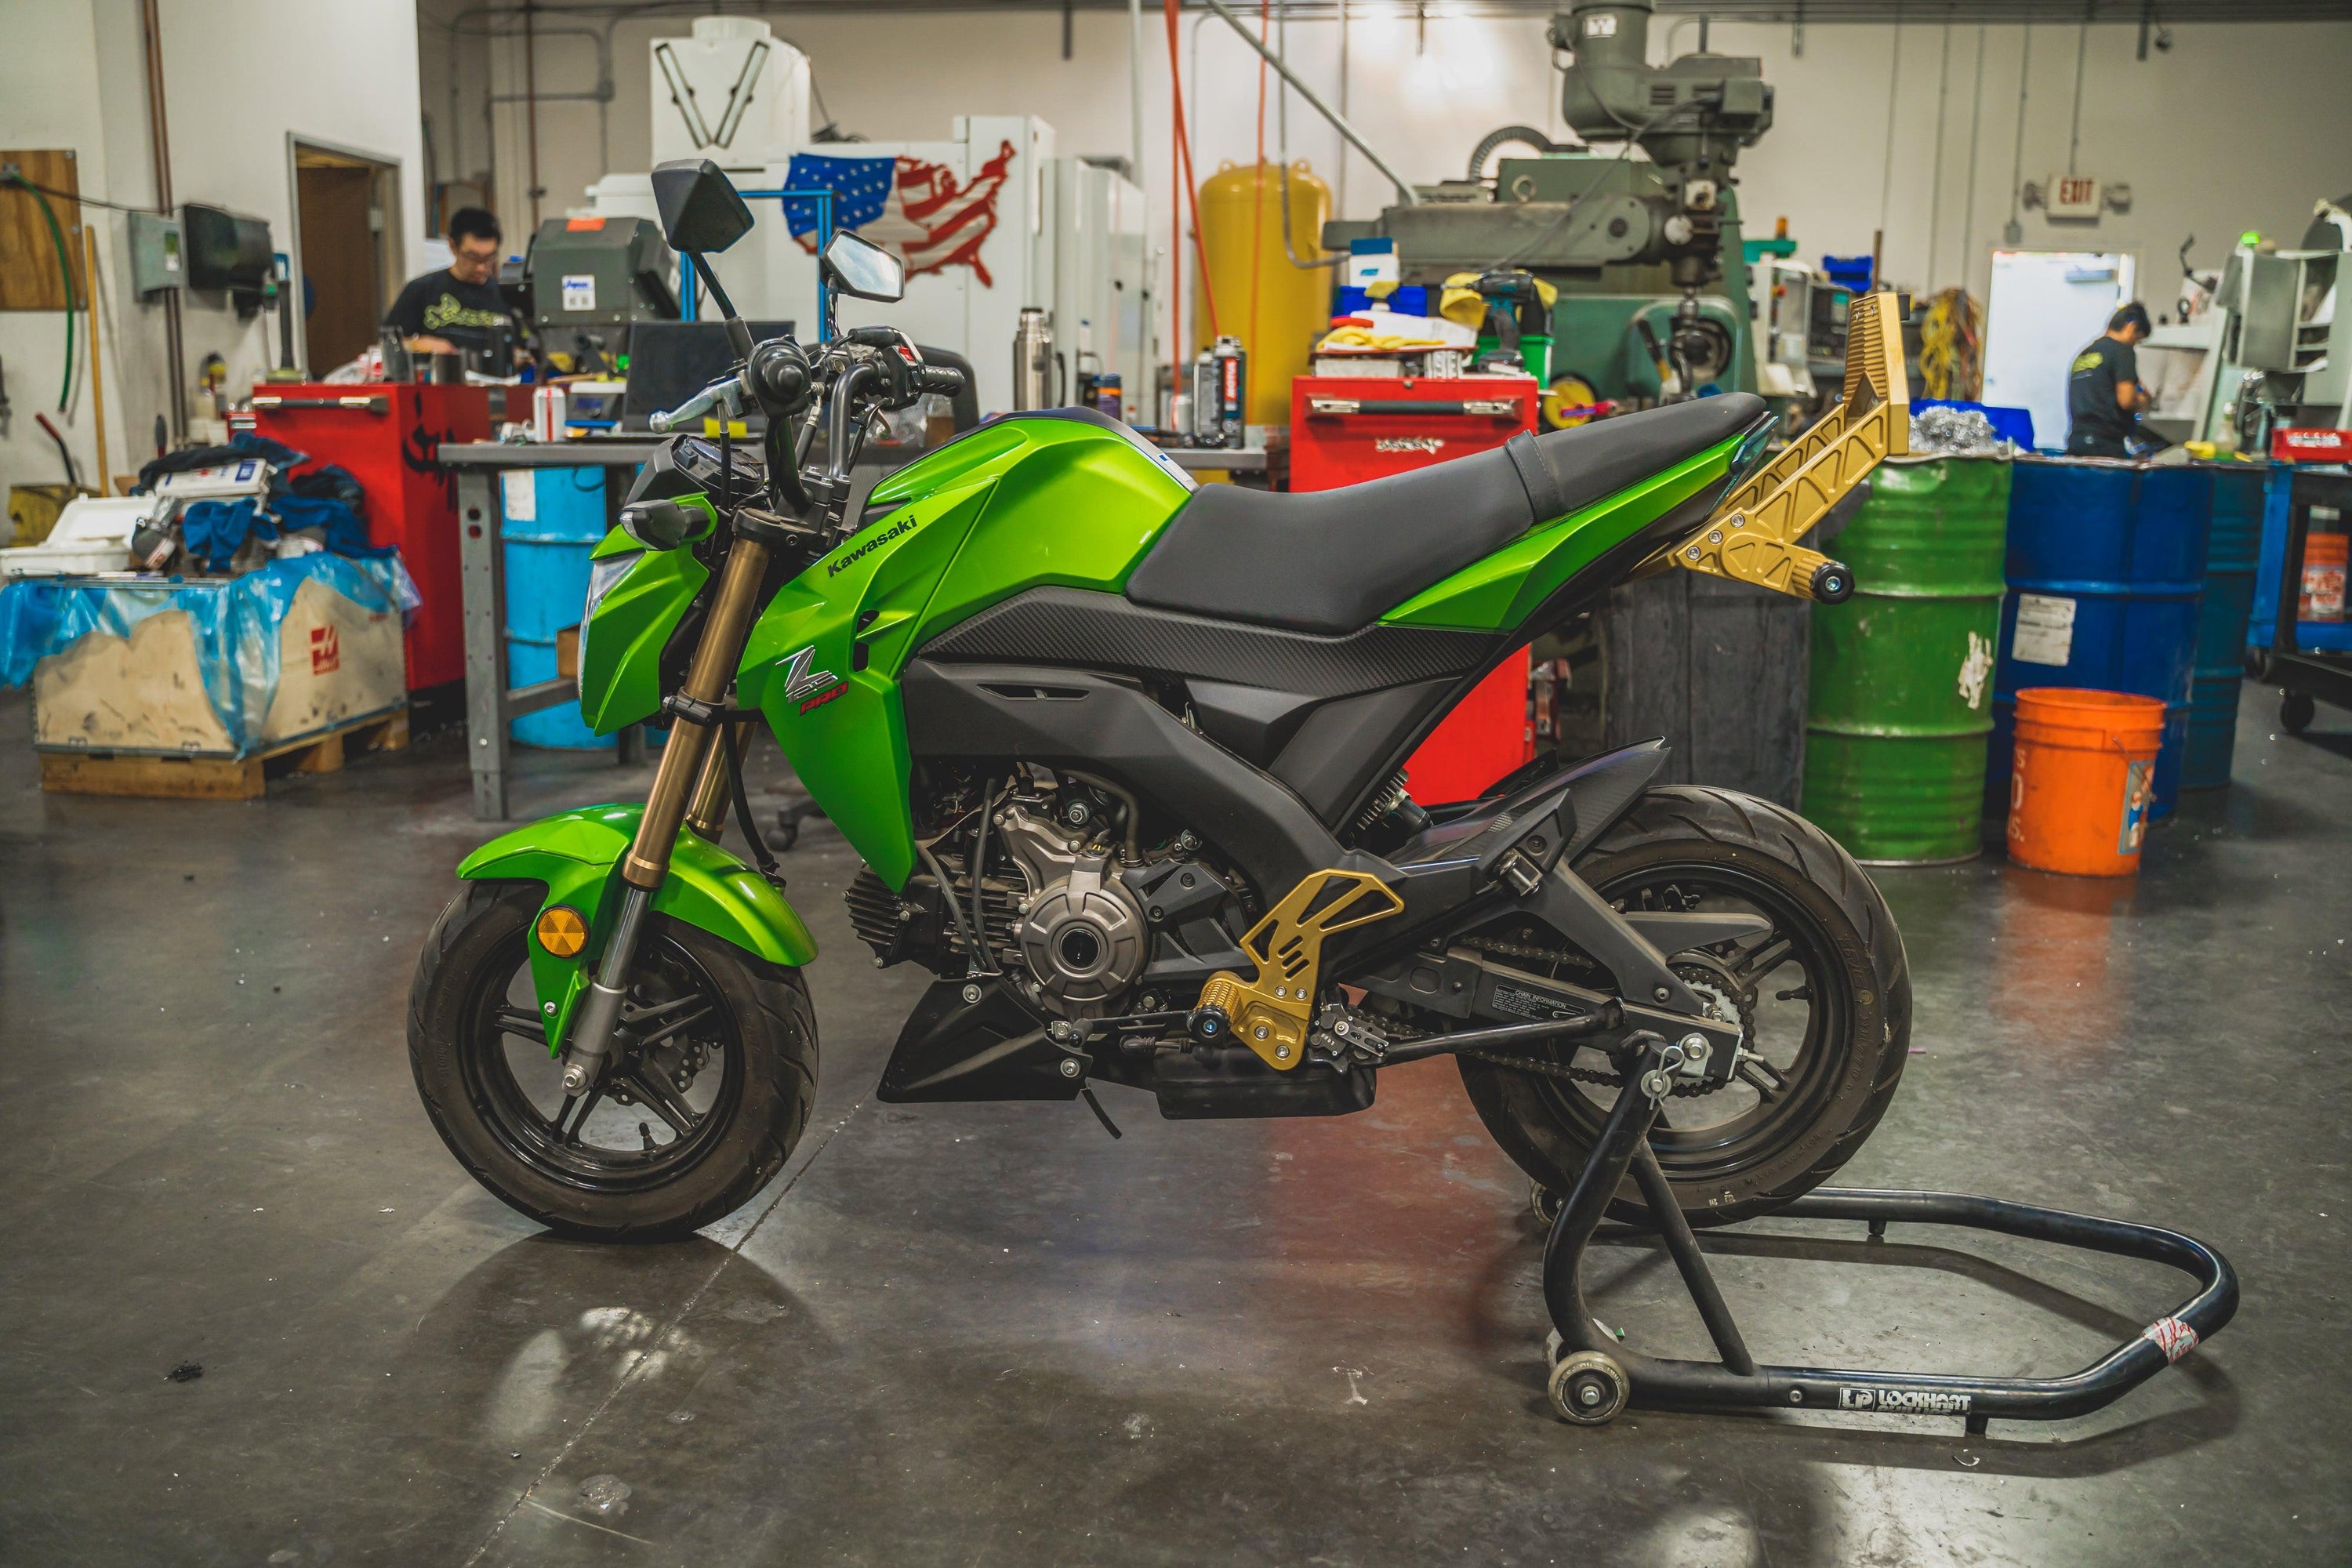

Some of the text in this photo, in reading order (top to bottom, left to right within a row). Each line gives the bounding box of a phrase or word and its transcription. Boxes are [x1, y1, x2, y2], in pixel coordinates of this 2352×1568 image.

[2060, 177, 2092, 204] EXIT
[827, 514, 917, 578] Kawasaki
[800, 681, 849, 717] PRO
[1515, 989, 1567, 1009] CHAIN INFORMATION
[1878, 1389, 1971, 1410] LOCKHART
